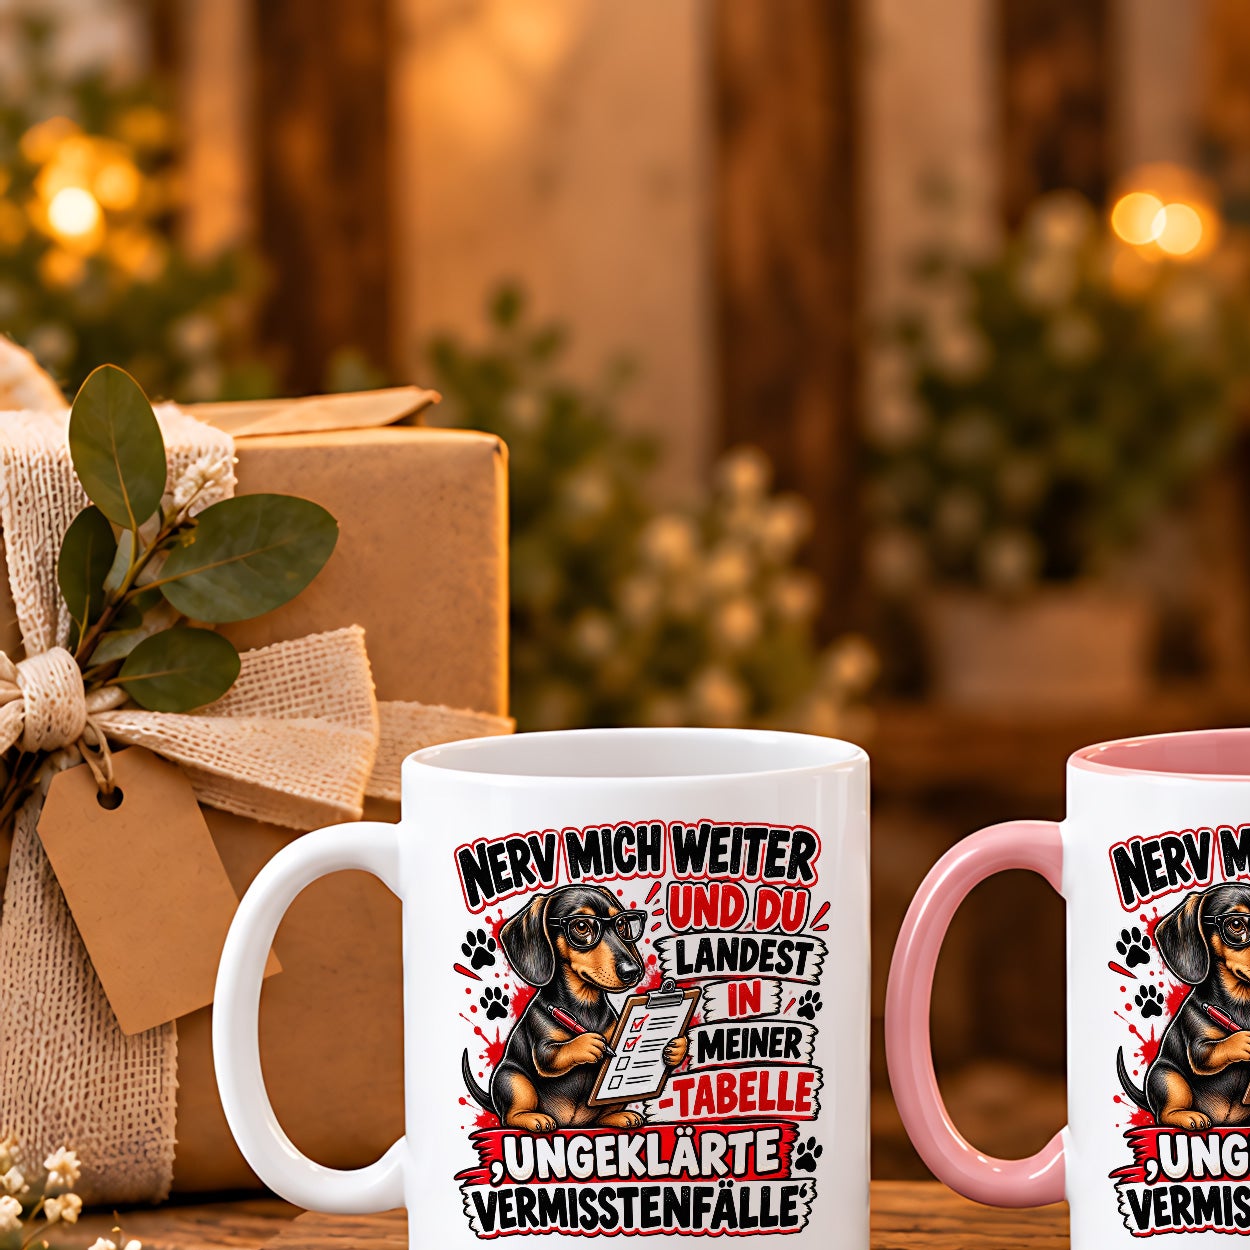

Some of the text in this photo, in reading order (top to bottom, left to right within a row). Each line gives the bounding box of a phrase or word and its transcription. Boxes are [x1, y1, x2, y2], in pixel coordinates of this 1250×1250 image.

[459, 824, 817, 906] NERV MICH WEITER
[1114, 831, 1210, 904] NERV
[669, 883, 807, 929] UND DU
[676, 939, 814, 974] LANDEST
[728, 982, 761, 1016] IN
[700, 1027, 800, 1061] MEINER
